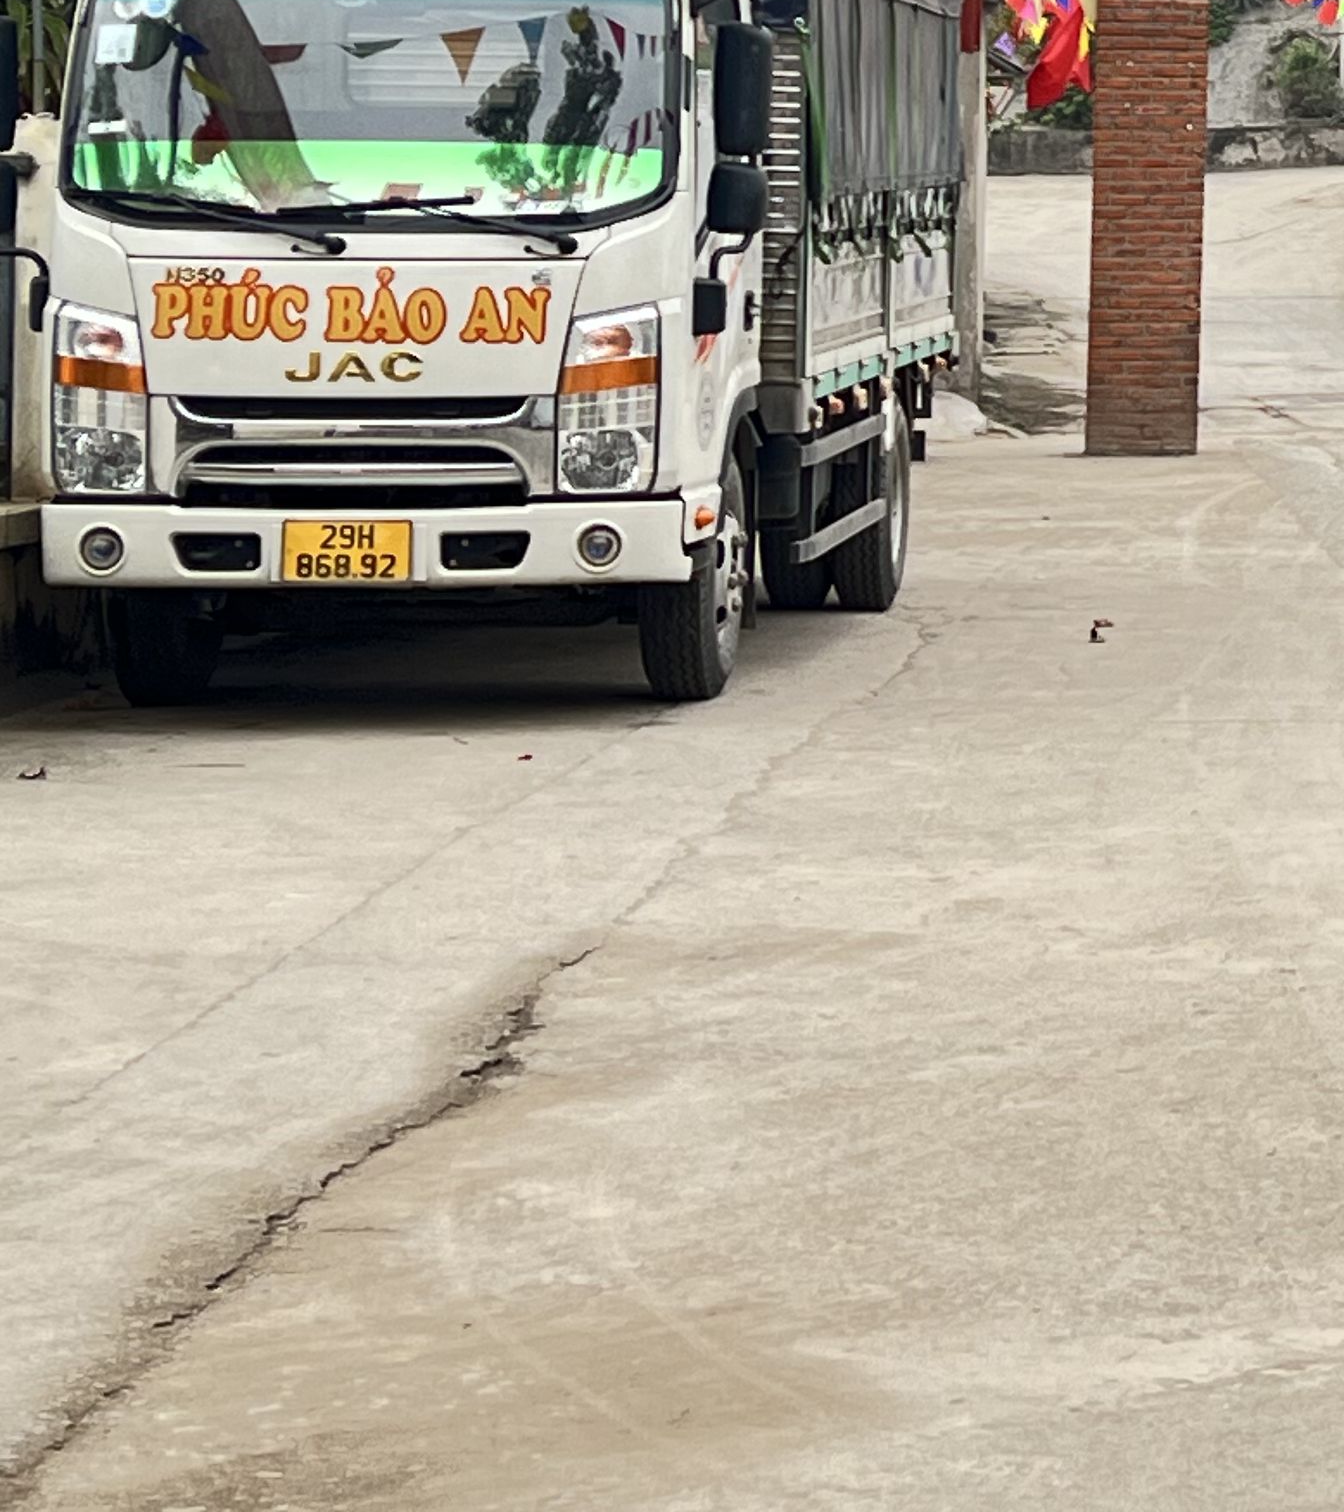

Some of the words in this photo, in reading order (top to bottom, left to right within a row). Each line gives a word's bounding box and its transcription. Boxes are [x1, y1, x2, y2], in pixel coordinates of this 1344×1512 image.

[151, 267, 309, 341] PHÚC
[324, 266, 447, 344] BẢO
[459, 285, 551, 343] AN
[285, 352, 424, 382] JAC
[320, 524, 375, 549] 29H
[296, 553, 397, 579] 868.92
